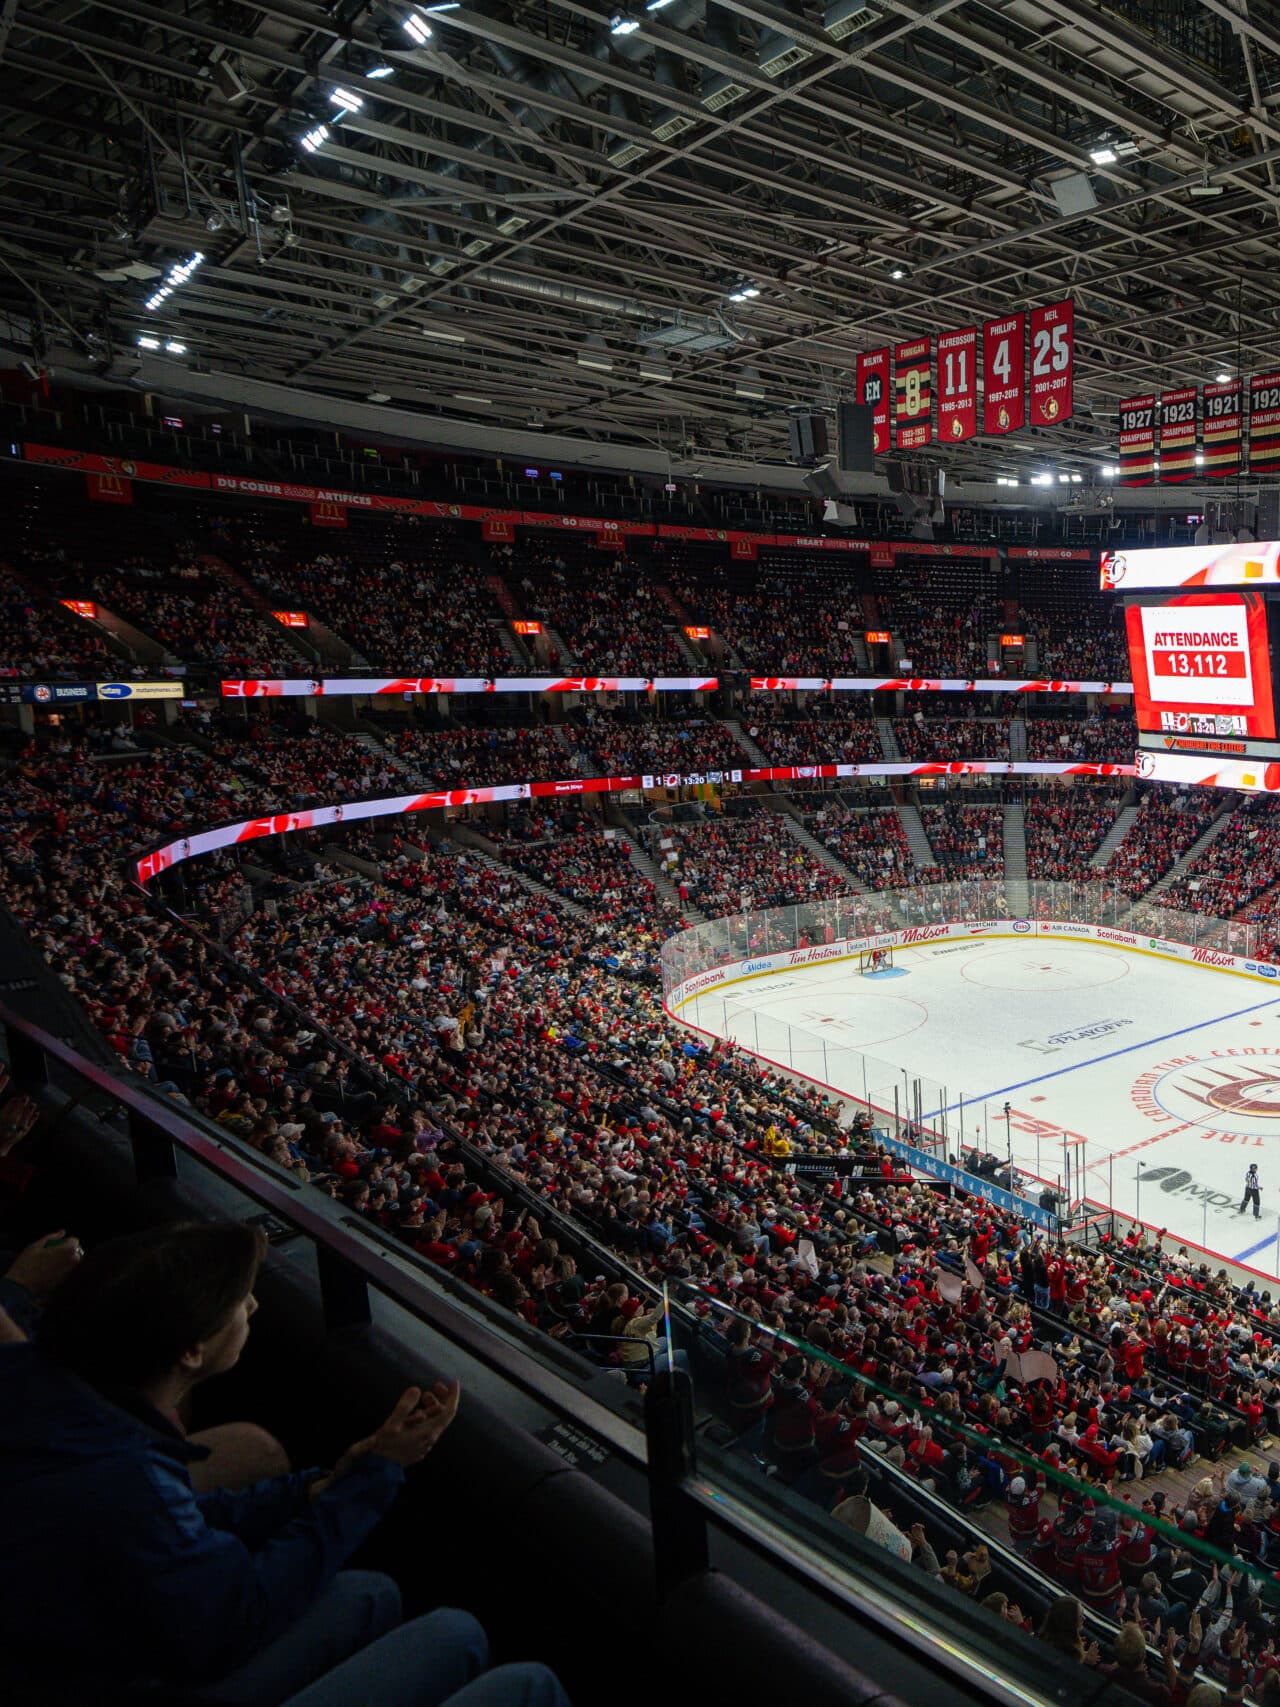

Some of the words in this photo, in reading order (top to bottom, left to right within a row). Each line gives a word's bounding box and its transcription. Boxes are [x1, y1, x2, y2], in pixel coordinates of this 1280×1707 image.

[1045, 309, 1059, 321] NEIL
[990, 321, 1017, 336] PHILLIPS
[939, 333, 975, 349] ALFREDSSON
[1033, 324, 1069, 377] 25
[993, 339, 1011, 384] 4
[945, 350, 968, 396] 11
[866, 381, 880, 401] EM
[905, 369, 920, 416] 8
[1035, 377, 1067, 393] 2001-2017
[1207, 393, 1239, 416] 1921
[1121, 410, 1152, 428] 1927
[1163, 402, 1194, 424] 1923
[1120, 431, 1153, 444] CHAMPIONS
[1162, 424, 1195, 437] CHAMPIONS
[217, 478, 237, 488] DU
[239, 481, 282, 494] COEUR
[317, 490, 372, 505] ARTIFICES
[562, 518, 577, 526] GO
[604, 521, 618, 530] GO
[797, 538, 824, 546] HEART
[1027, 549, 1039, 557] GO
[1060, 549, 1072, 557] GO
[1154, 632, 1239, 647] ATTENDANCE
[1168, 653, 1228, 677] 13,112
[56, 688, 87, 697] BUSINESS
[656, 777, 661, 785] 1
[684, 776, 705, 785] 13:20
[724, 773, 729, 781] 1
[901, 925, 949, 944] Molson
[1015, 923, 1029, 931] Esso
[1063, 926, 1090, 935] CANADA
[1097, 928, 1137, 945] Scotiabank
[850, 940, 867, 951] intact
[789, 953, 806, 965] Tim
[807, 947, 842, 961] Hortons
[1191, 946, 1235, 967] Molson
[748, 960, 773, 973] Midea
[684, 969, 726, 994] Scotiabank
[1048, 1018, 1133, 1046] PLAYOFFS
[1131, 1072, 1173, 1123] CANADIAN
[1152, 1054, 1200, 1071] TIRE
[1200, 1130, 1265, 1147] TIRE
